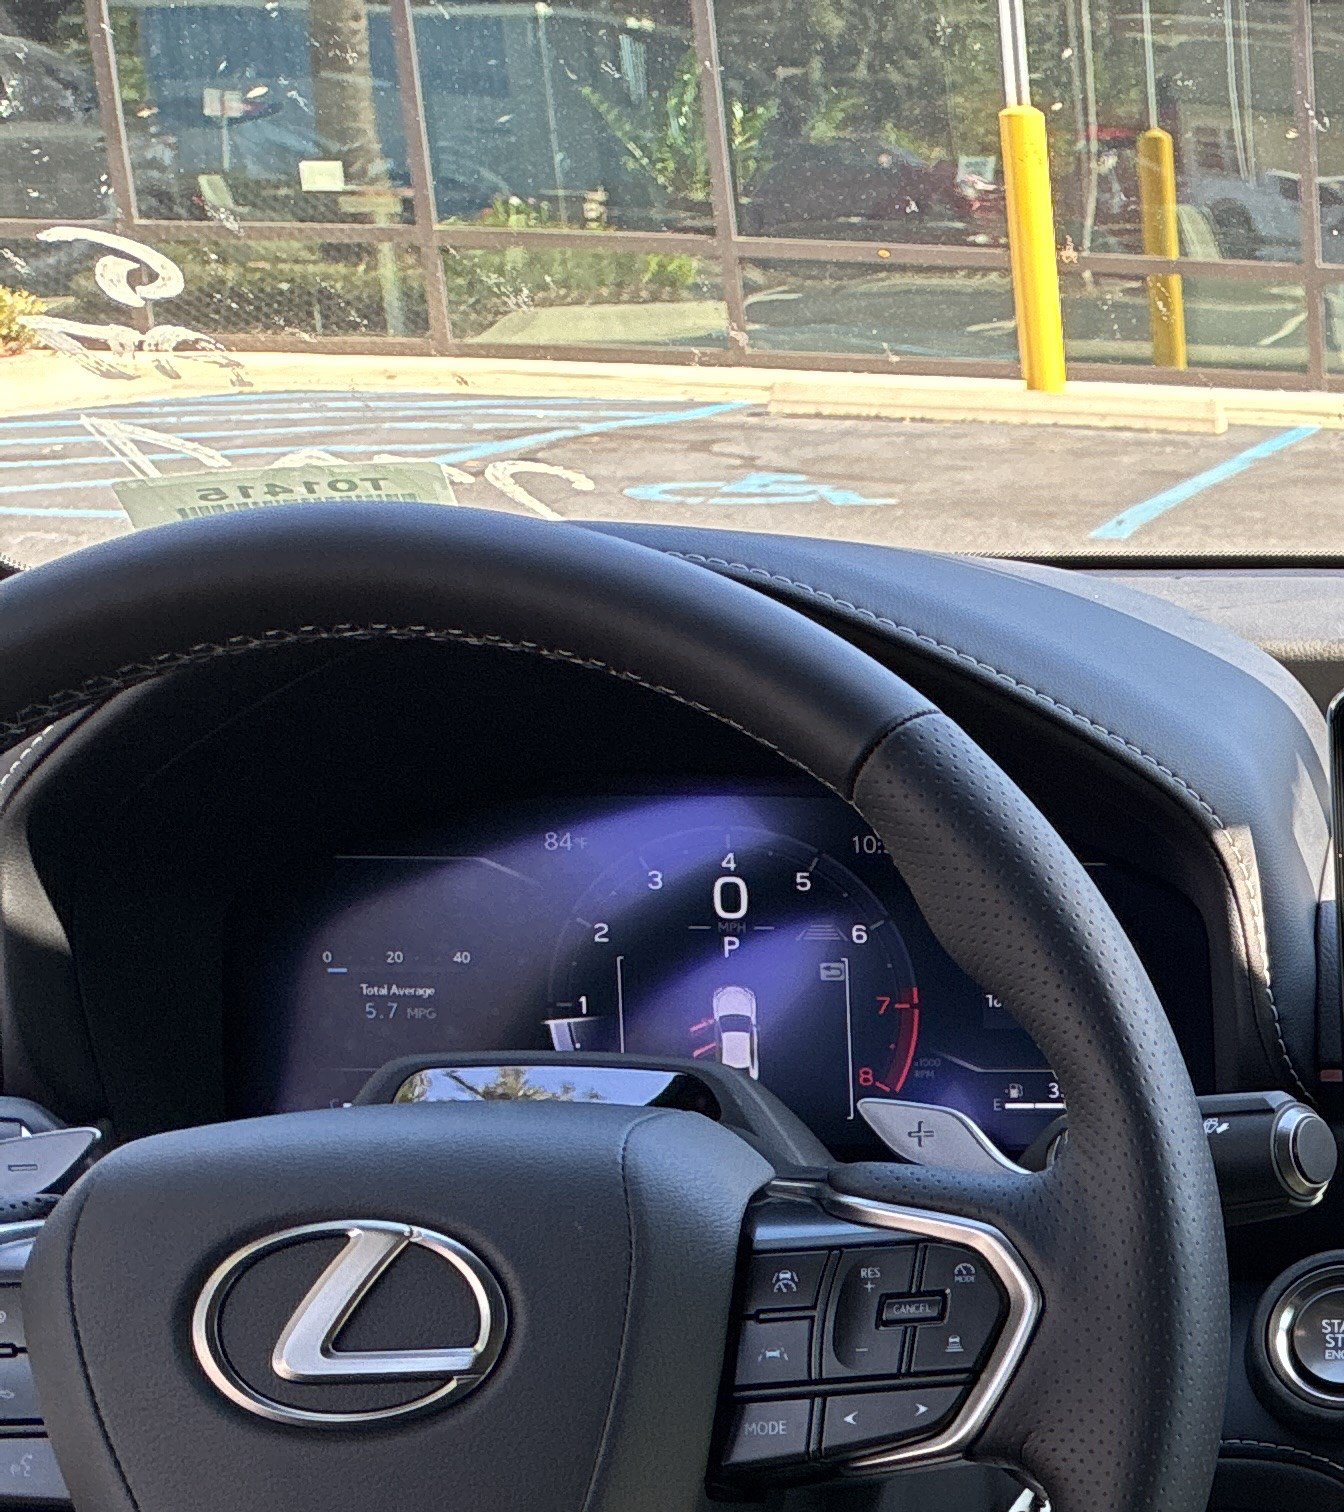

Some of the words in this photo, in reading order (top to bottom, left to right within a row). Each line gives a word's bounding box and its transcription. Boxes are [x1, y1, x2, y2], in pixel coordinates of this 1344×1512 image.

[721, 853, 736, 872] 4
[648, 870, 663, 890] 3
[795, 872, 811, 892] 5
[713, 876, 749, 919] 0
[593, 923, 610, 943] 2
[717, 922, 747, 933] MPH
[851, 924, 868, 944] 6
[723, 936, 740, 958] P
[322, 951, 332, 963] 0
[386, 951, 404, 963] 20
[452, 952, 471, 964] 40
[360, 984, 388, 996] Total
[390, 984, 435, 998] Average
[365, 1002, 398, 1019] 5.7
[406, 1007, 437, 1019] MPG
[578, 996, 588, 1014] 1
[876, 996, 891, 1015] 7
[858, 1067, 874, 1086] 8
[860, 1267, 881, 1279] RES
[892, 1303, 932, 1315] CANCEL
[744, 1421, 787, 1436] MODE
